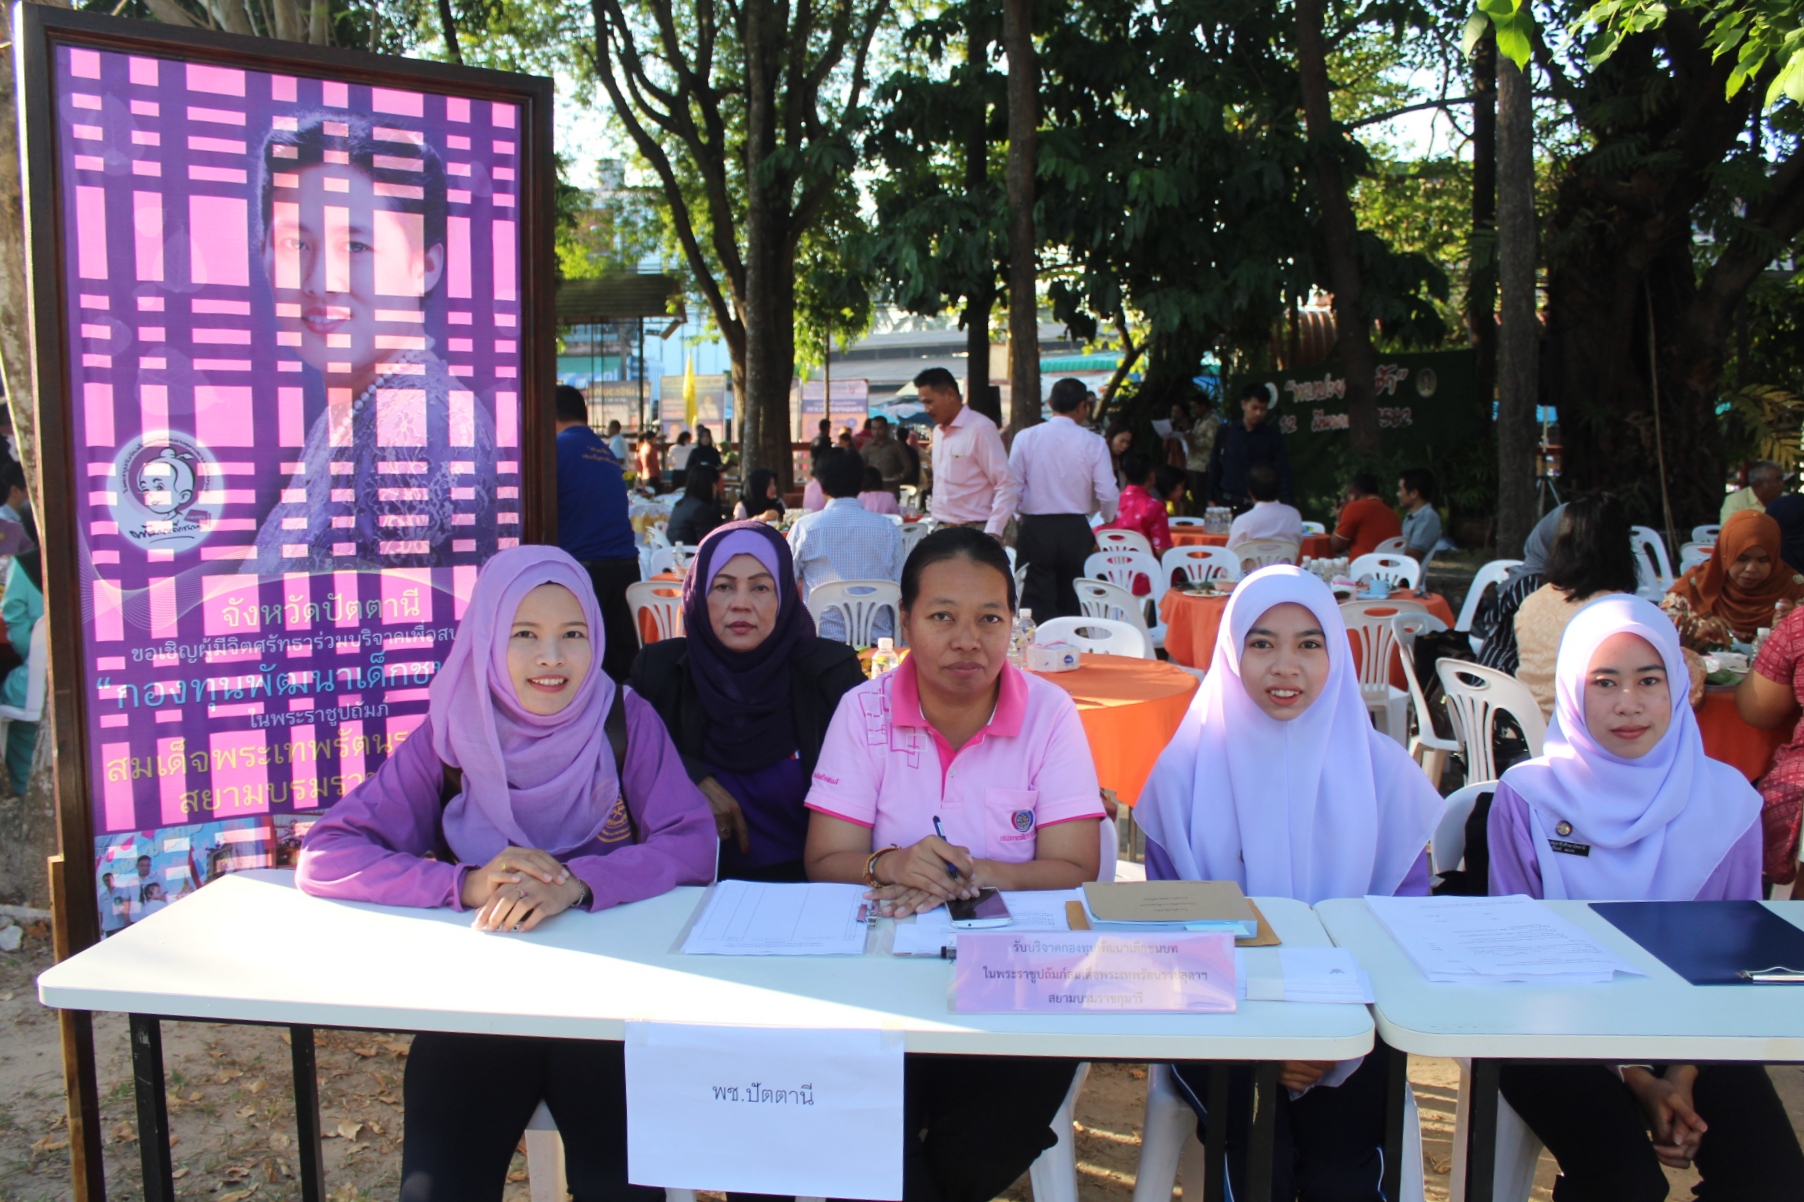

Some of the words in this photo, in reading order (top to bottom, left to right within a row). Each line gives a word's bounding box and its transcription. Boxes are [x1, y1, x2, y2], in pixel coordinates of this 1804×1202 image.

[221, 588, 421, 629] จังหวัดปัตตานี
[248, 697, 390, 730] ในพระราชูปถัมภ์
[179, 771, 376, 815] สยามบรมรา
[1048, 991, 1144, 1008] สยามบรมราชกุมารี
[712, 1082, 815, 1106] พช.ปัตตานี
